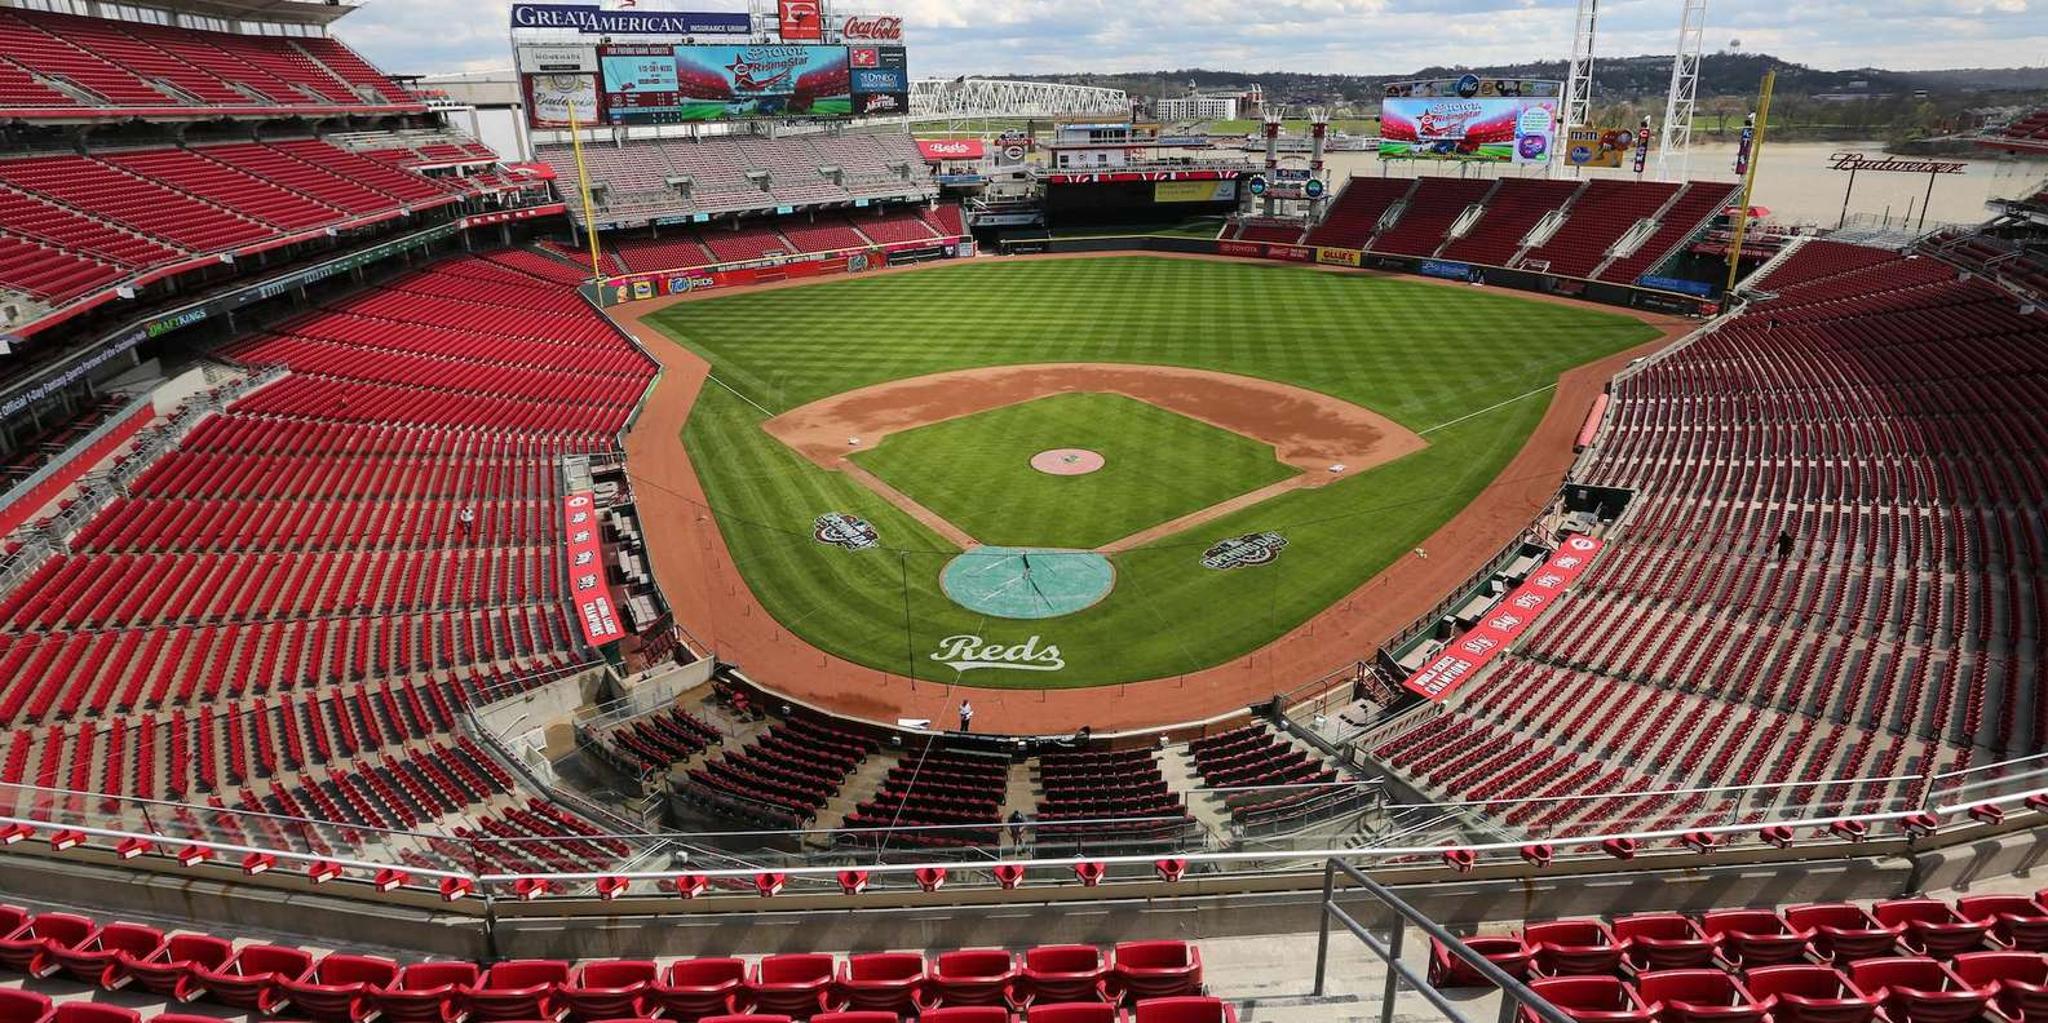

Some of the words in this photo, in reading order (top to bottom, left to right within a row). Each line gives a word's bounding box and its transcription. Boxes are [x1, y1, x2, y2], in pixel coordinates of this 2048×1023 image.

[583, 12, 684, 32] AMERICAN
[929, 142, 970, 153] Reds
[1826, 153, 1968, 174] Budweiser
[930, 635, 1066, 672] Reds
